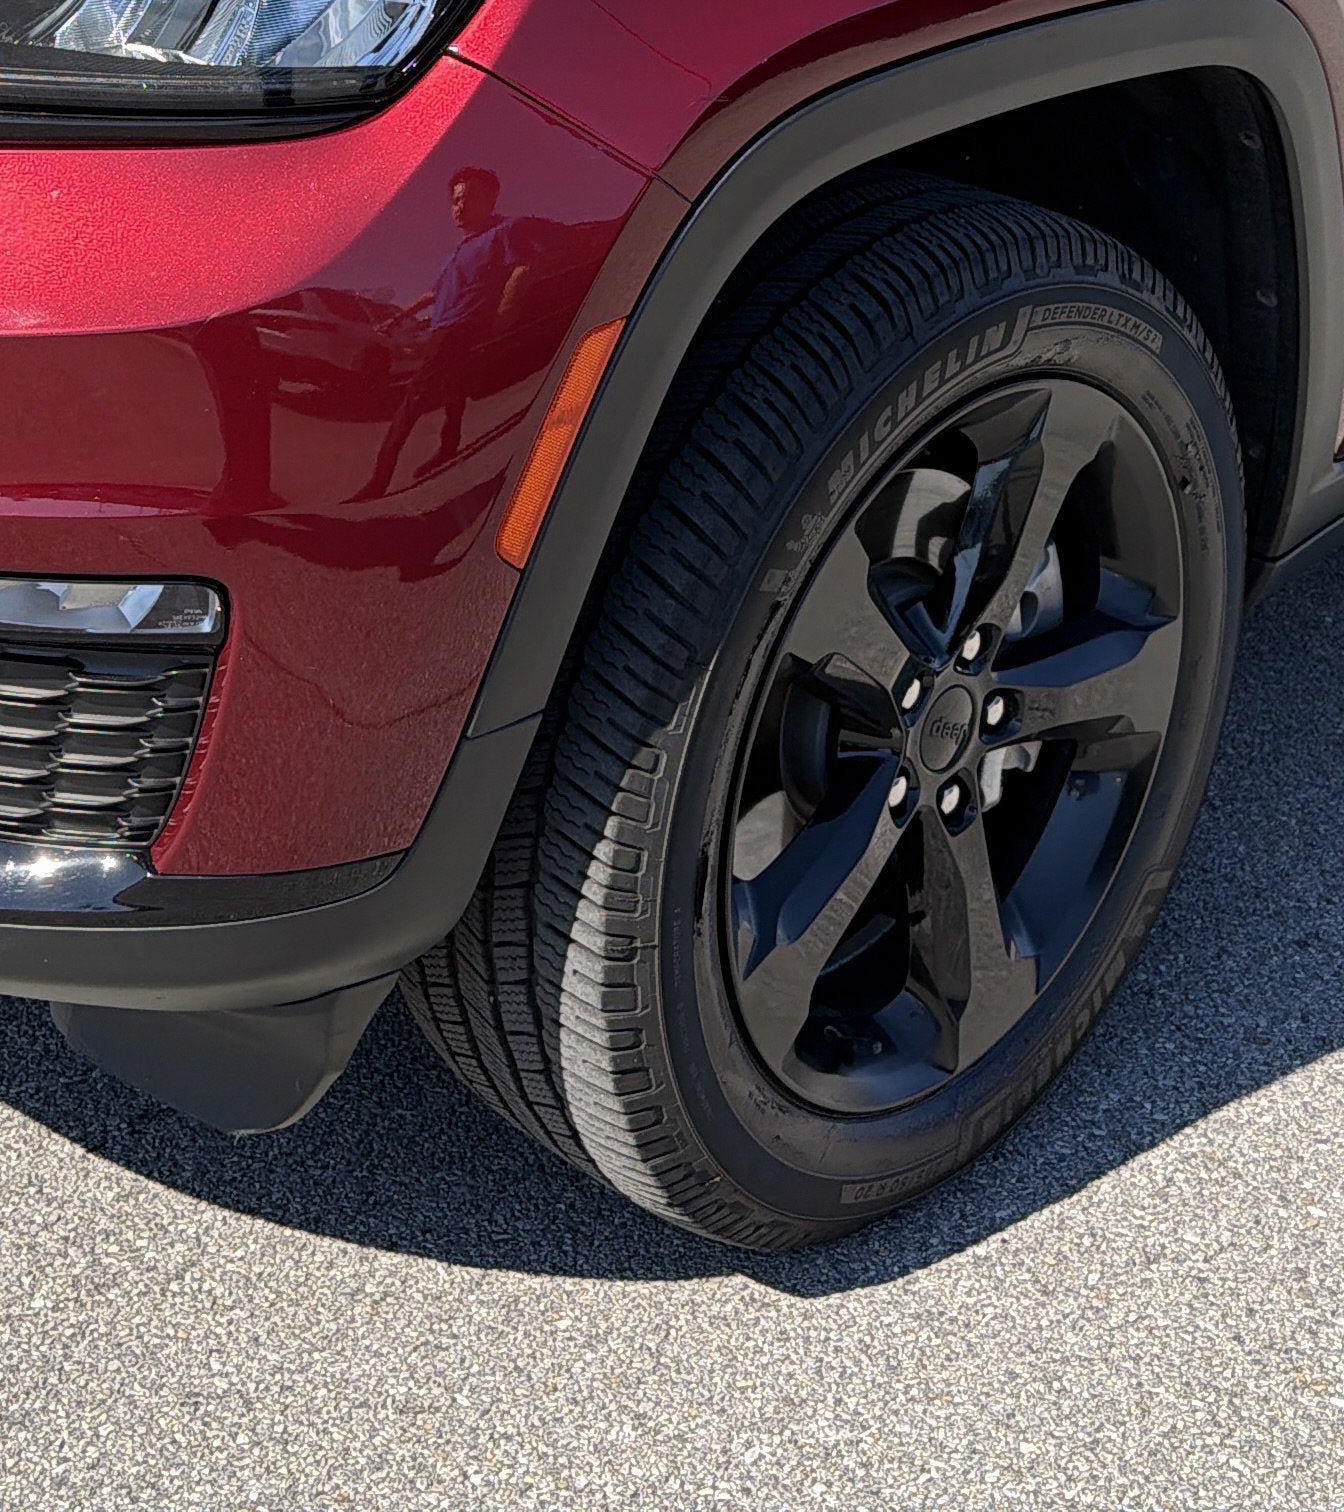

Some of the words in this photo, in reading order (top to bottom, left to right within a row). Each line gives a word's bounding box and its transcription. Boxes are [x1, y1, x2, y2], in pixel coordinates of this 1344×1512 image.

[828, 319, 1007, 504] MICHELIN
[1041, 304, 1108, 322] DEFENDER
[1107, 309, 1132, 329] LTX
